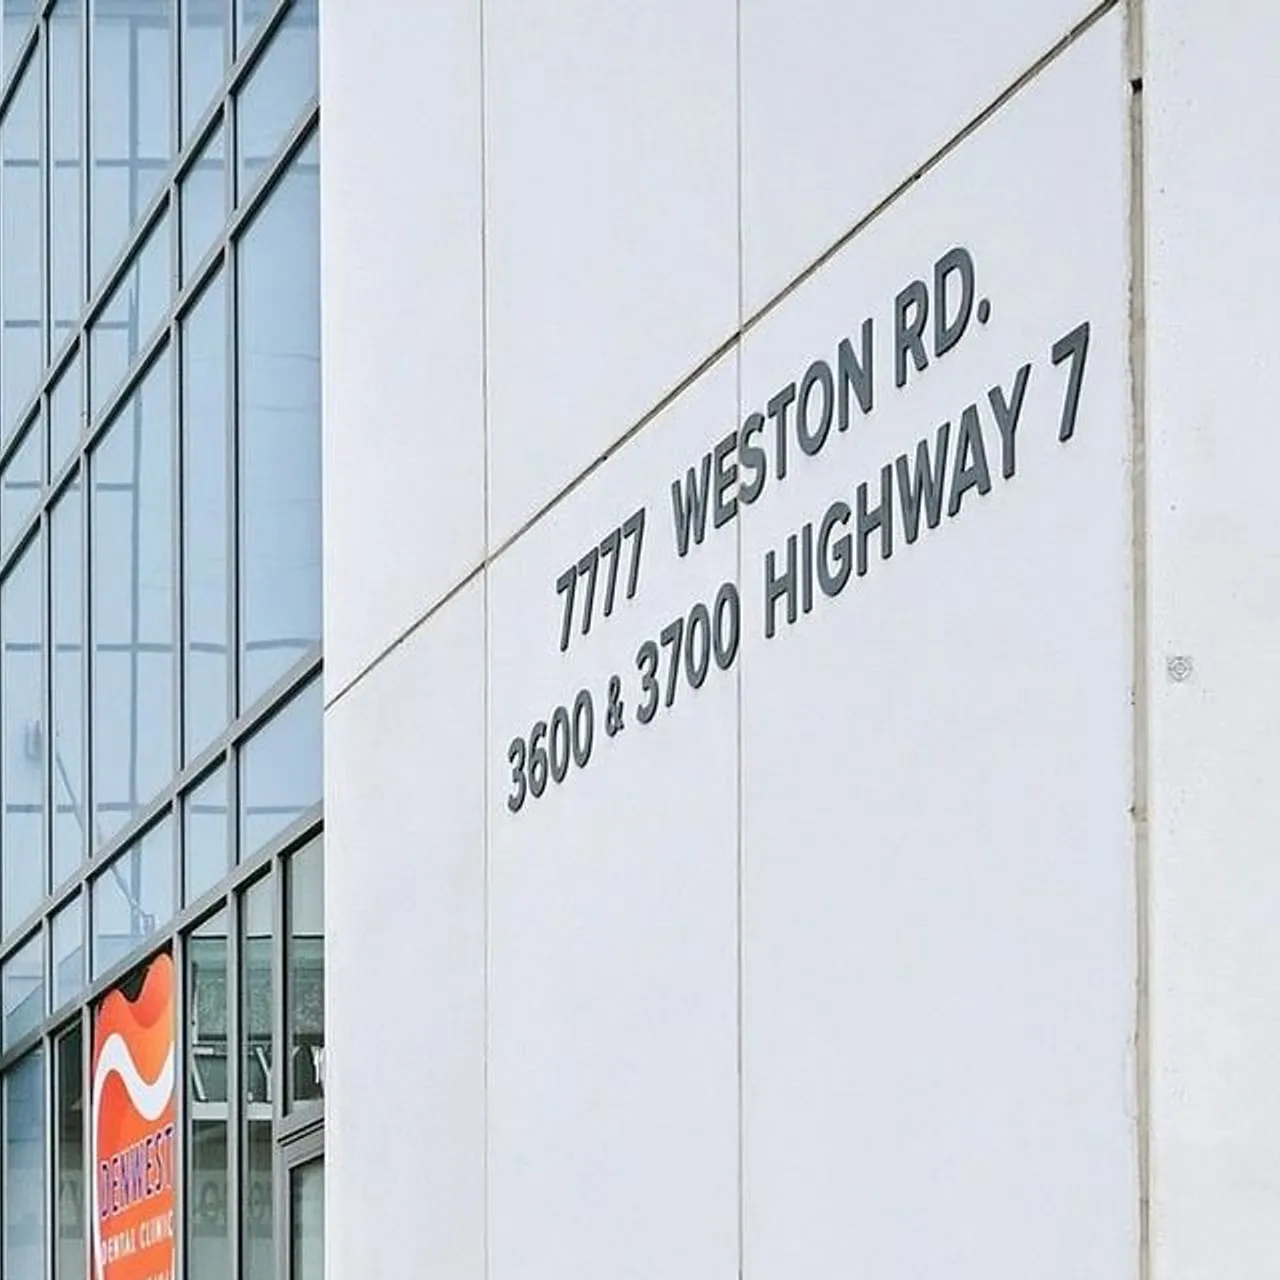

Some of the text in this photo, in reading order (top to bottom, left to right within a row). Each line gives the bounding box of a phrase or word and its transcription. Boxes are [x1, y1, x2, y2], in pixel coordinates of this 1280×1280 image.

[507, 321, 1091, 814] 3600 & 3700 HIGHWAY 7
[555, 246, 992, 652] 7777 WESTON RD.
